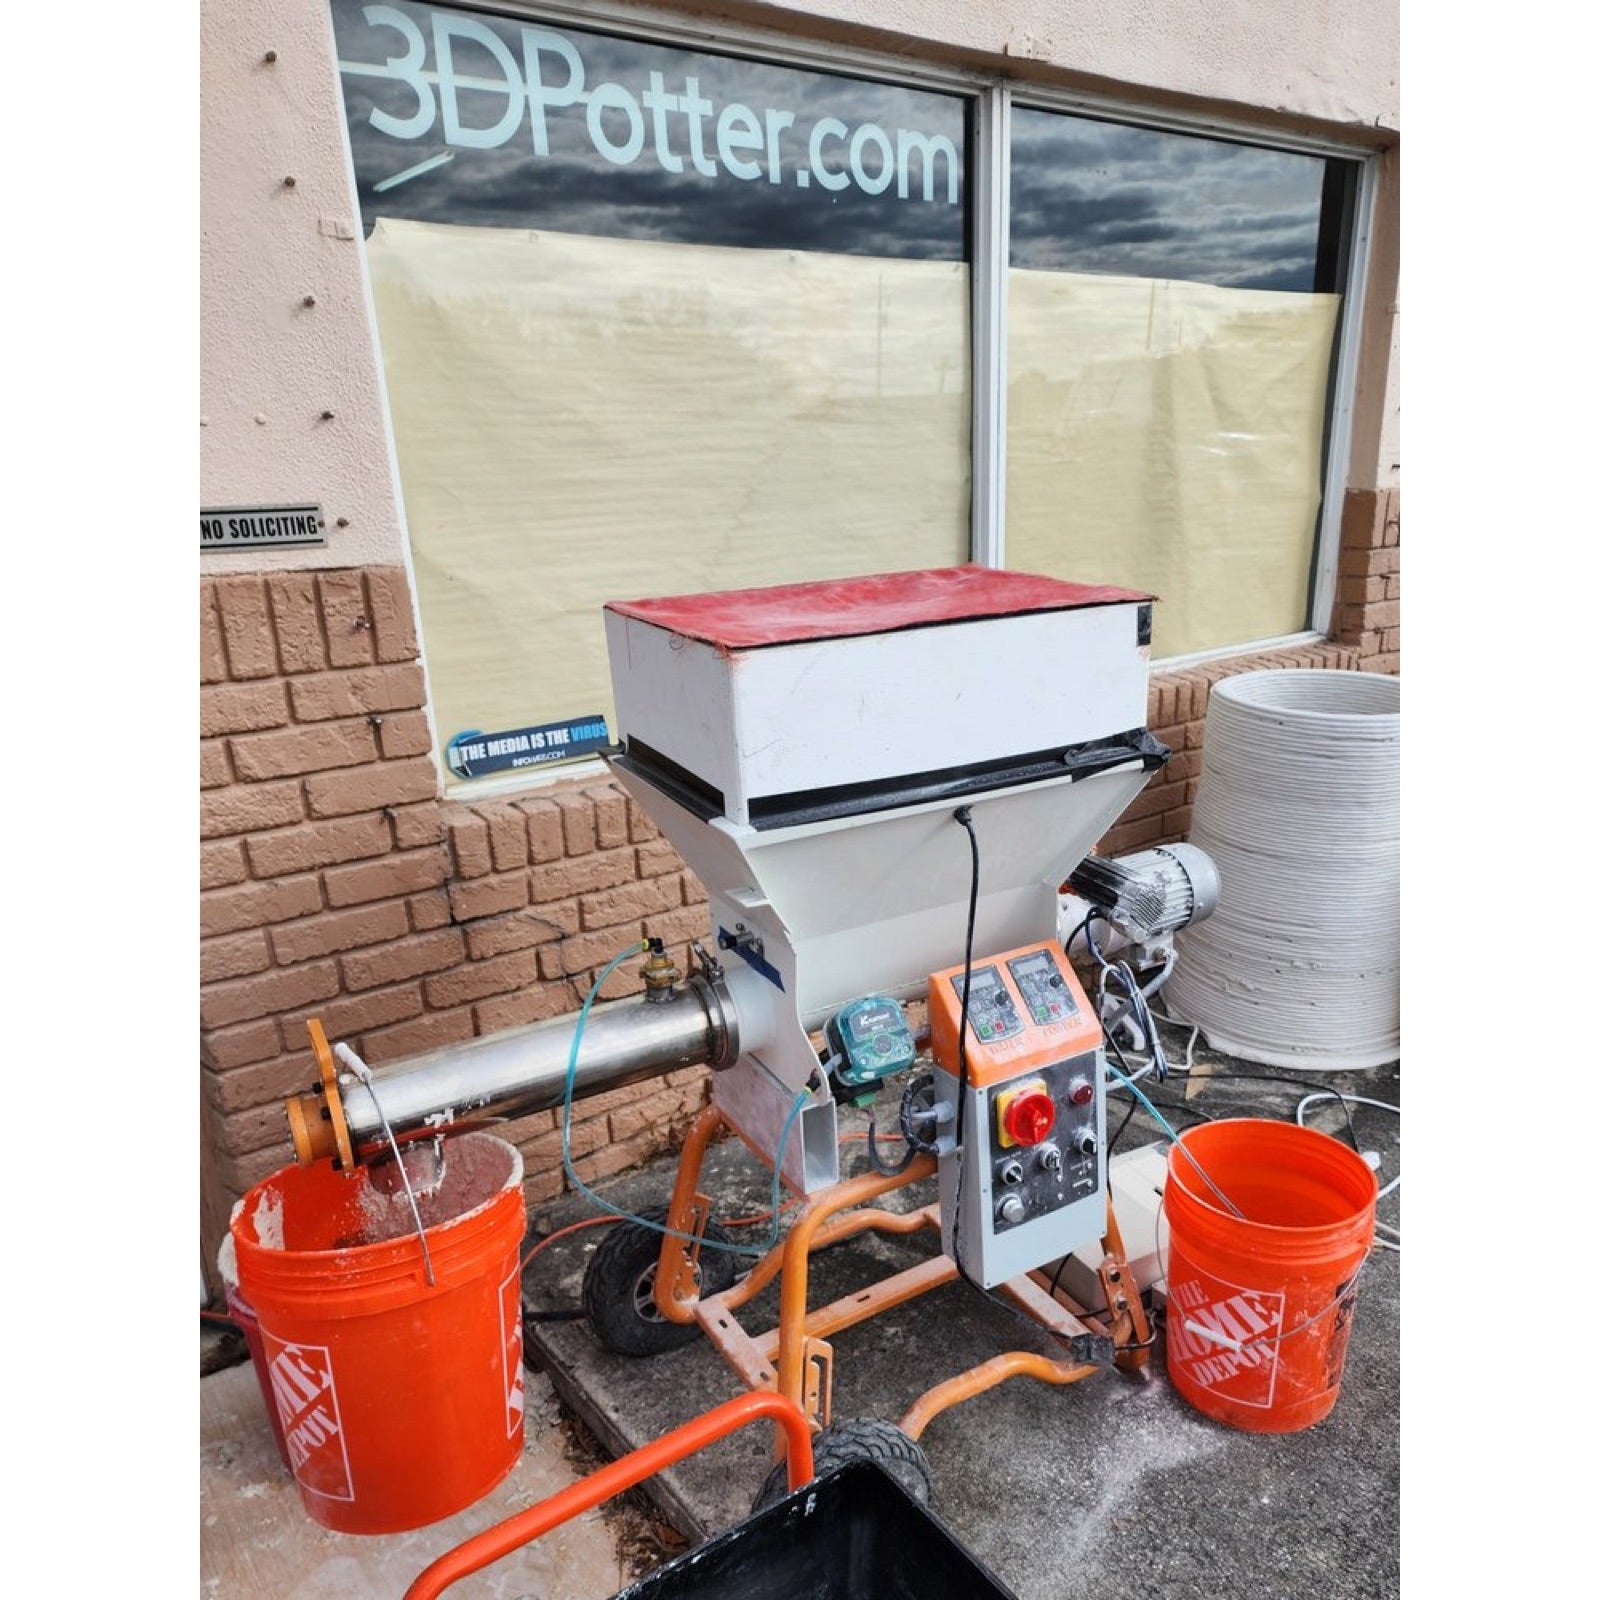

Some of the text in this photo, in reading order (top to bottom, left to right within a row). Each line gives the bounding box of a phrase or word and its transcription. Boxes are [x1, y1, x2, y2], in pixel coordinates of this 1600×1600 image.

[364, 6, 957, 203] 3DPotter.com
[200, 515, 318, 540] NO SOLICITING
[461, 722, 608, 761] THE MEDIA IS THE VIRUS
[1192, 1337, 1277, 1386] DEPOT
